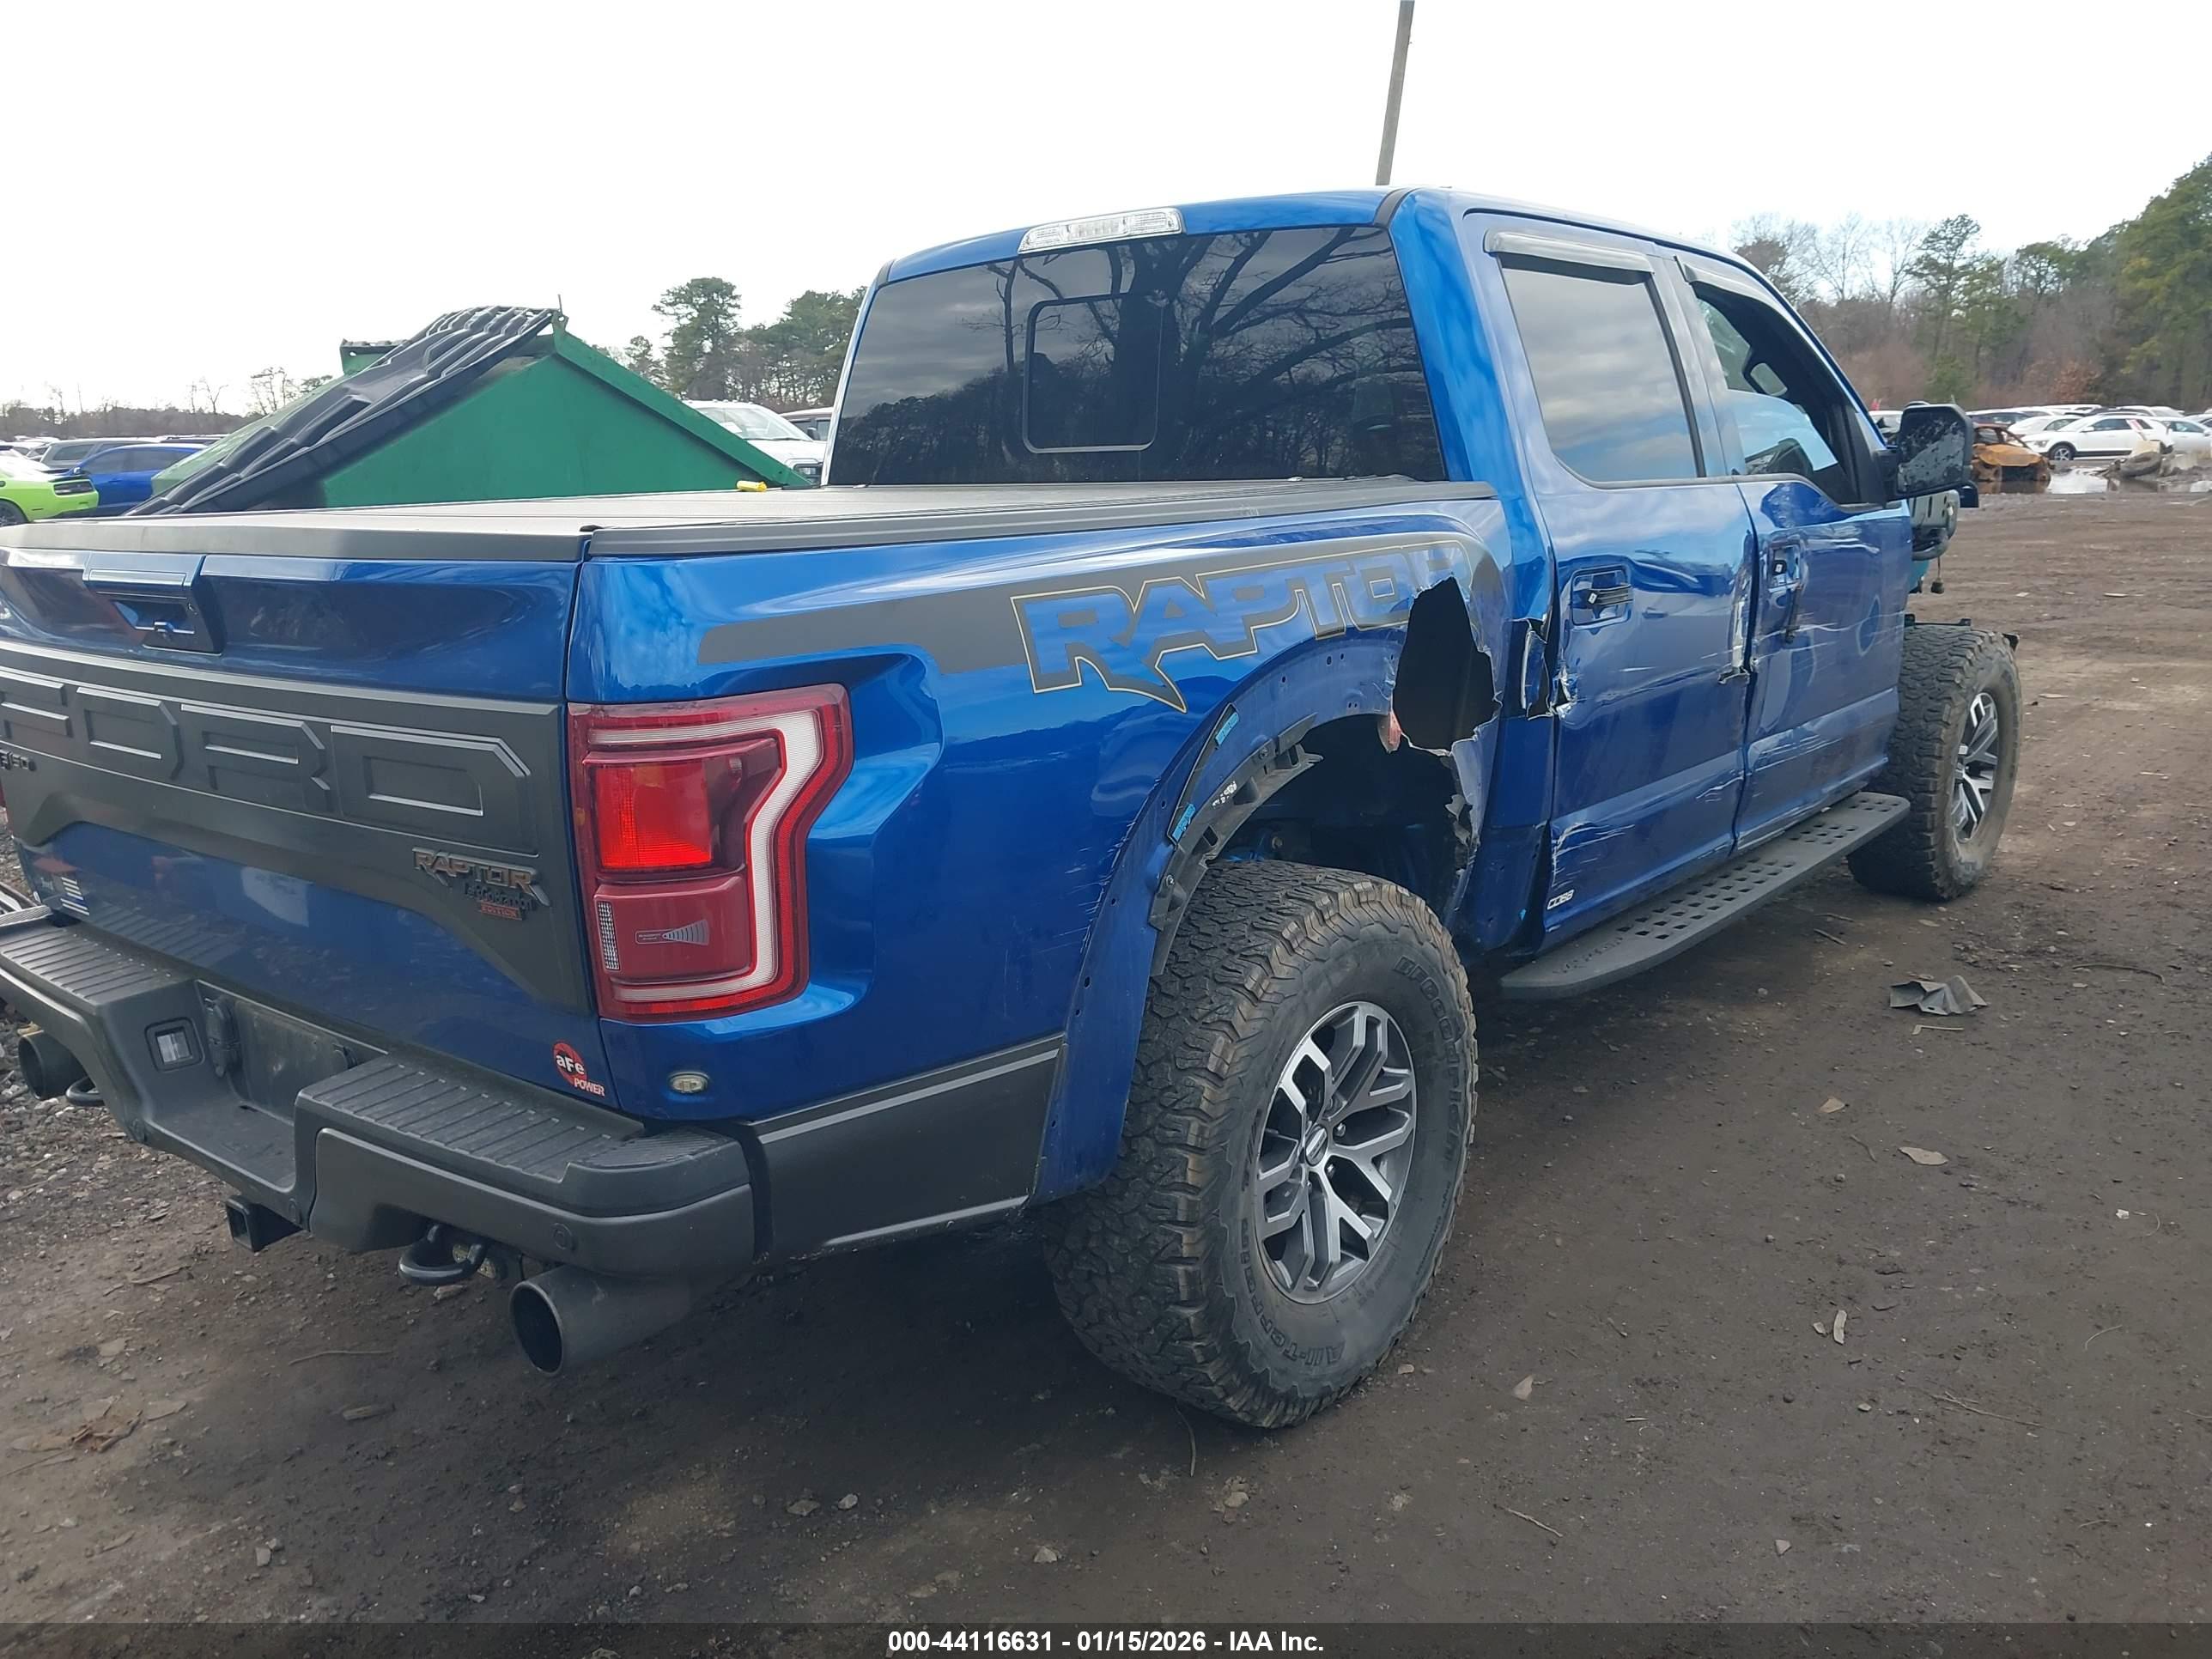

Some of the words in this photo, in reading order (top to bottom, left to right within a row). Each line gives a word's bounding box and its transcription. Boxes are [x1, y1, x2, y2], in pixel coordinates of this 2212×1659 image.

[0, 670, 534, 850] FORD
[412, 847, 550, 906] RAPTOR
[556, 1054, 585, 1075] aFe
[573, 1077, 605, 1097] POWER
